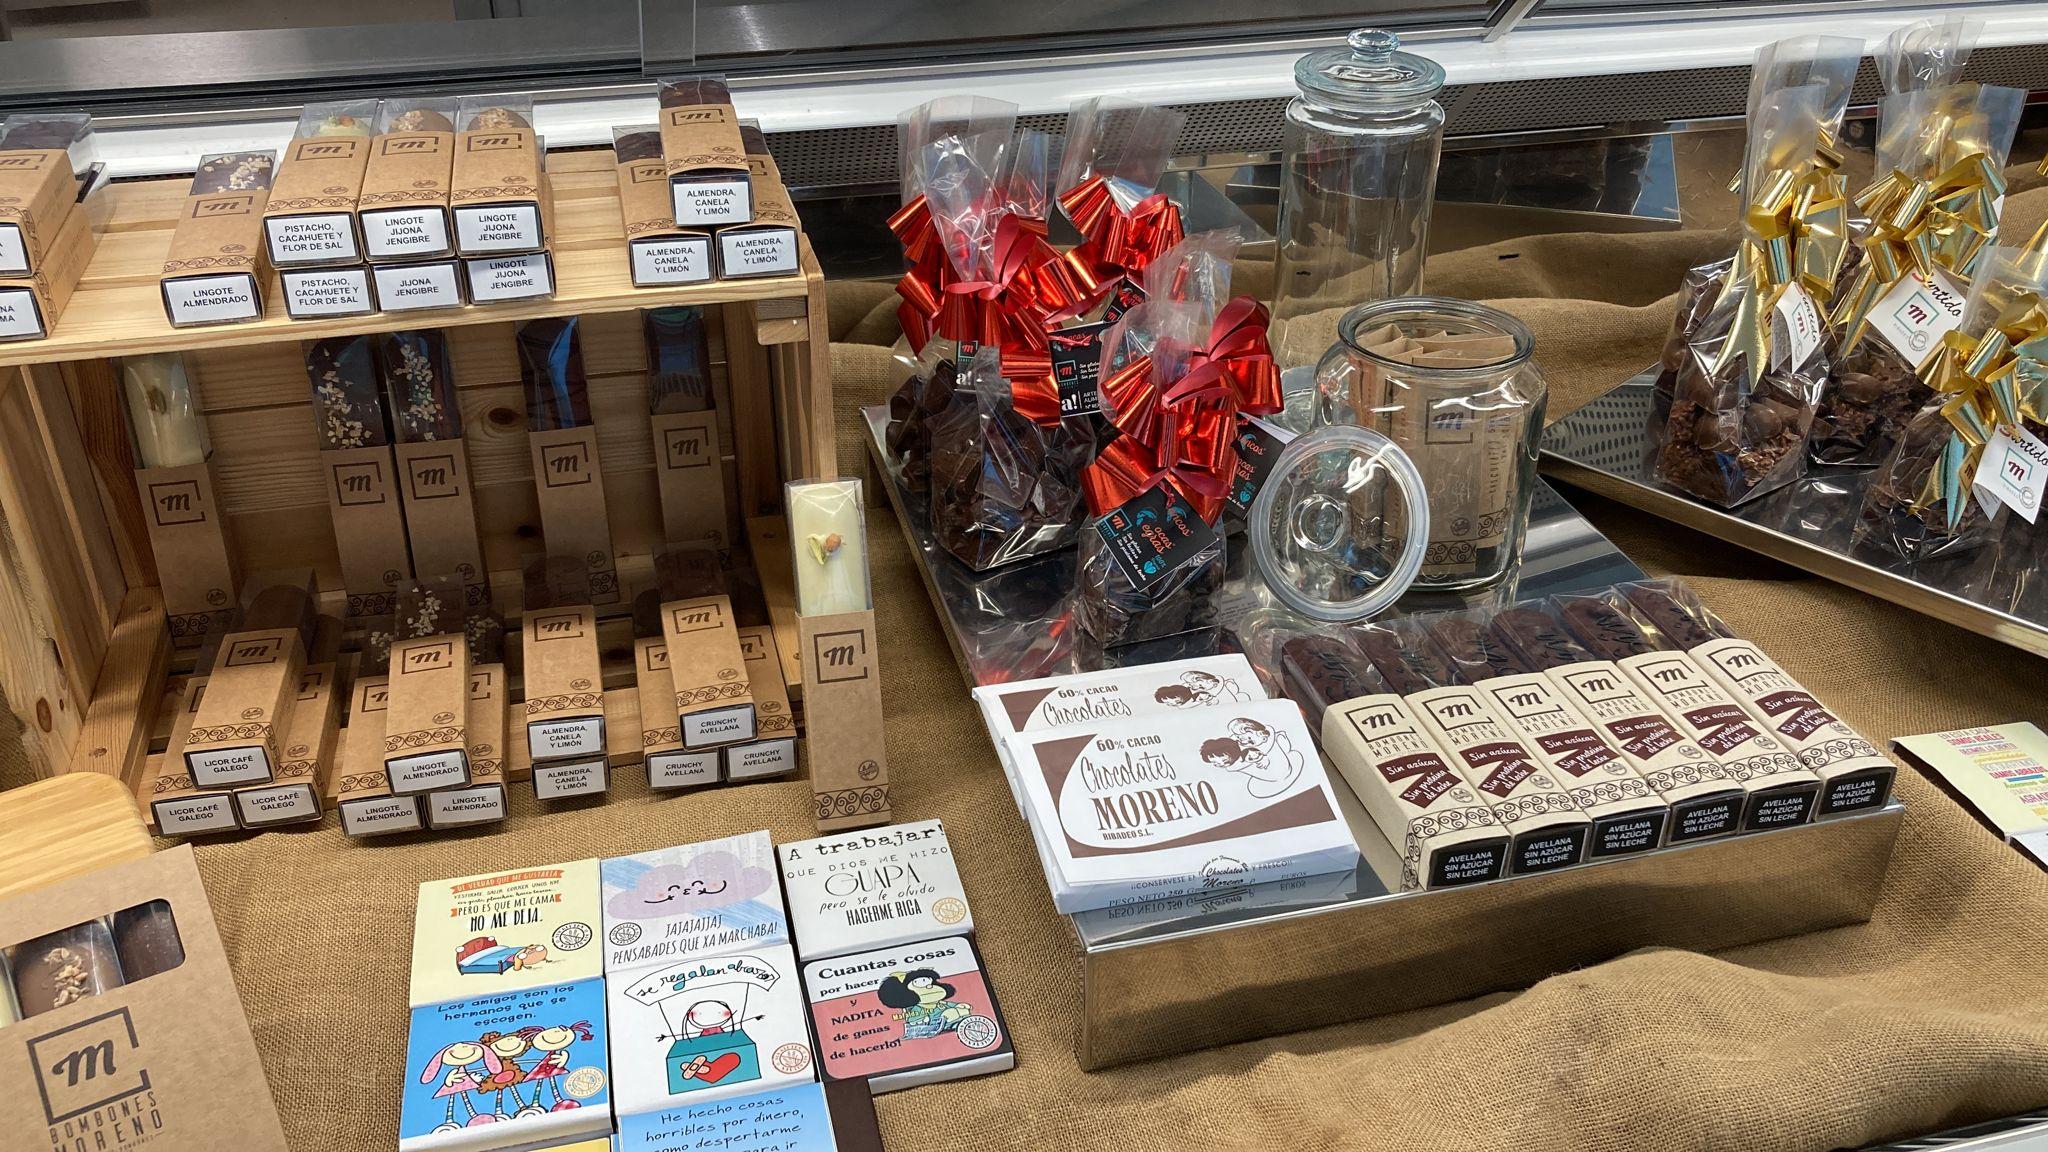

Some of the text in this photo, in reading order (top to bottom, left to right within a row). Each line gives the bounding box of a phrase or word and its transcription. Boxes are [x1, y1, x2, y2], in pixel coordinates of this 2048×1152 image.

[686, 189, 736, 198] ALMENDRA,
[695, 198, 730, 206] CANELA
[704, 206, 730, 214] LIMÓN
[385, 216, 424, 226] LINGOTE
[479, 214, 518, 223] LINGOTE
[284, 223, 334, 233] PISTACHO,
[390, 227, 422, 236] JIJONA
[484, 224, 516, 232] JIJONA
[278, 232, 334, 243] CACAHUETE
[386, 234, 430, 246] JENGIBRE
[478, 232, 522, 242] JENGIBRE
[283, 242, 343, 252] FLOR DE SAL
[646, 248, 696, 256] ALMENDRA,
[490, 260, 528, 270] LINGOTE
[654, 256, 689, 265] CANELA
[663, 262, 690, 272] LIMÓN
[495, 270, 526, 279] JIJONA
[302, 278, 350, 287] PISTACHO,
[400, 278, 432, 287] JIJONA
[491, 279, 534, 290] JENGIBRE
[192, 287, 234, 298] LINGOTE
[295, 286, 359, 297] CACAHUETE Y
[395, 286, 439, 297] JENGIBRE
[183, 295, 248, 308] ALMENDRADO
[300, 298, 324, 306] FLOR
[340, 296, 358, 304] SAL
[1058, 685, 1119, 699] 60% CACAO
[1043, 696, 1132, 727] Chocolates
[700, 718, 738, 728] CRUNCHY
[700, 724, 740, 734] AVELLANA
[542, 726, 588, 736] ALMENDRA,
[550, 733, 582, 741] CANELA
[558, 739, 582, 748] LIMÓN
[1096, 734, 1161, 752] 60% CACAO
[1545, 732, 1597, 750] Sin azúcar
[204, 755, 254, 767] LICOR CAFÉ
[742, 756, 782, 766] AVELLANA
[744, 750, 780, 760] CRUNCHY
[214, 764, 248, 773] GALEGO
[412, 761, 448, 772] LINGOTE
[666, 761, 703, 770] CRUNCHY
[1386, 759, 1440, 776] Sin azúcar
[402, 766, 459, 780] ALMENDRADO
[664, 768, 704, 777] AVELLANA
[1080, 752, 1176, 794] Chocolates
[1836, 780, 1876, 792] AVELLANA
[252, 792, 300, 804] LICOR CAFÉ
[1832, 787, 1876, 800] SIN AZÚCAR
[260, 801, 294, 810] GALEGO
[452, 796, 487, 804] LINGOTE
[1090, 780, 1220, 831] MORENO
[1832, 796, 1870, 808] SIN LECHE
[366, 805, 400, 814] LINGOTE
[442, 802, 498, 812] ALMENDRADO
[356, 810, 412, 823] ALMENDRADO
[1608, 821, 1651, 834] AVELLANA
[1103, 828, 1154, 841] RIBADEO S.L.
[1604, 828, 1652, 842] SIN AZÚCAR
[788, 824, 945, 861] A trabajar!
[1606, 837, 1648, 848] SIN LECHE
[787, 846, 948, 879] QUE DIOS ME HIZO
[1448, 851, 1492, 864] AVELLANA
[1444, 858, 1494, 872] SIN AZÚCAR
[1206, 867, 1243, 878] Chocolates
[1446, 868, 1489, 880] SIN LECHE
[825, 862, 920, 896] GUAPA
[458, 894, 555, 916] PERO ES QUE MI CAMA
[820, 901, 846, 914] pero
[858, 896, 868, 905] se
[878, 888, 887, 901] le
[846, 898, 922, 926] HACERME RICA
[470, 908, 543, 932] NO ME DEJA.
[612, 922, 778, 964] PENSABADES QUE XA MARCHABA!
[818, 948, 956, 979] Cuantas cosas
[637, 986, 660, 996] se
[660, 964, 727, 992] regalan
[820, 978, 880, 997] por hacer
[438, 984, 575, 1013] Los amigos son los
[850, 999, 857, 1007] y
[444, 996, 567, 1021] hermanos que se
[474, 1013, 536, 1027] escogen.
[832, 1010, 884, 1025] NADITA
[833, 1025, 890, 1042] de ganas
[830, 1038, 902, 1060] de hacerlo!
[662, 1096, 784, 1124] He hecho cosas
[50, 1091, 157, 1144] BOMBONES
[646, 1108, 804, 1142] horribles por dinero,
[696, 1124, 801, 1149] despertarme
[786, 1139, 798, 1150] ir
